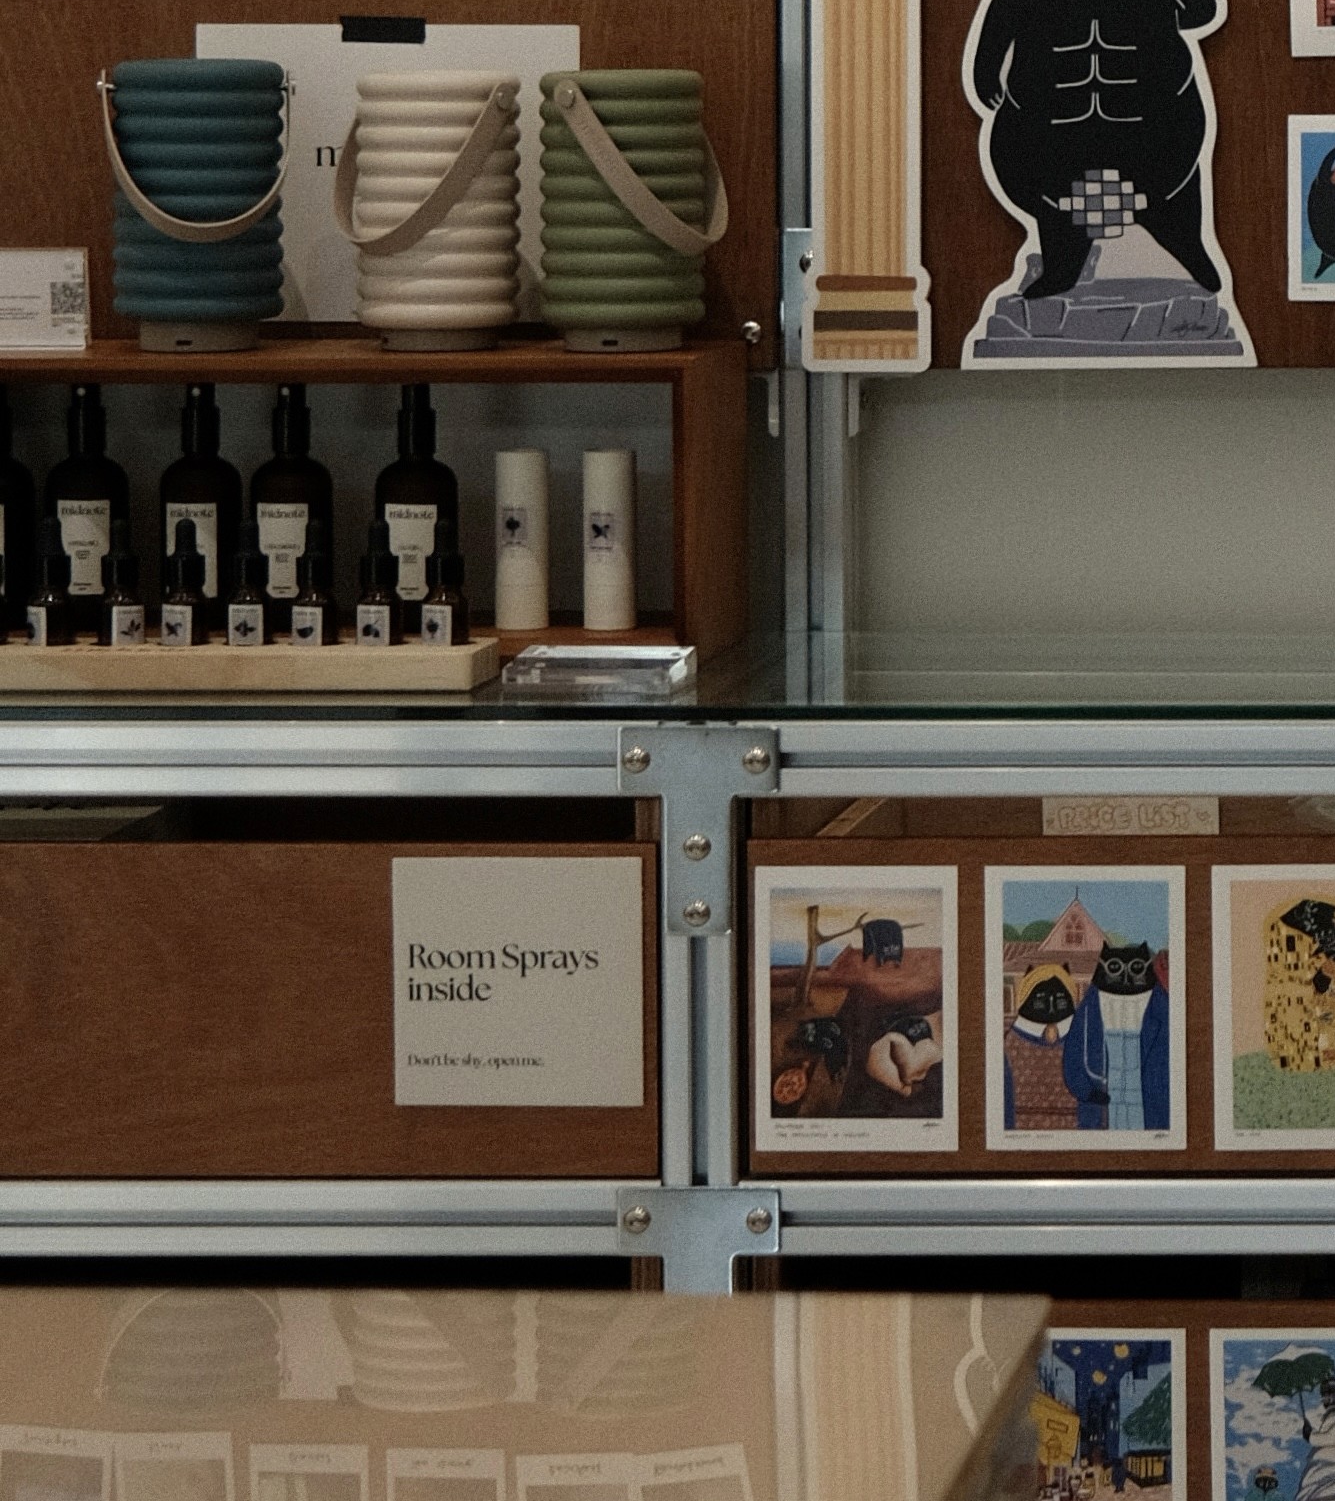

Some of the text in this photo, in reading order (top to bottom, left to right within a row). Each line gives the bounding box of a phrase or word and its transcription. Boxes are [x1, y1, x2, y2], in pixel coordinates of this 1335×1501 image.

[408, 943, 599, 978] Room Sprays
[408, 973, 492, 1002] inside
